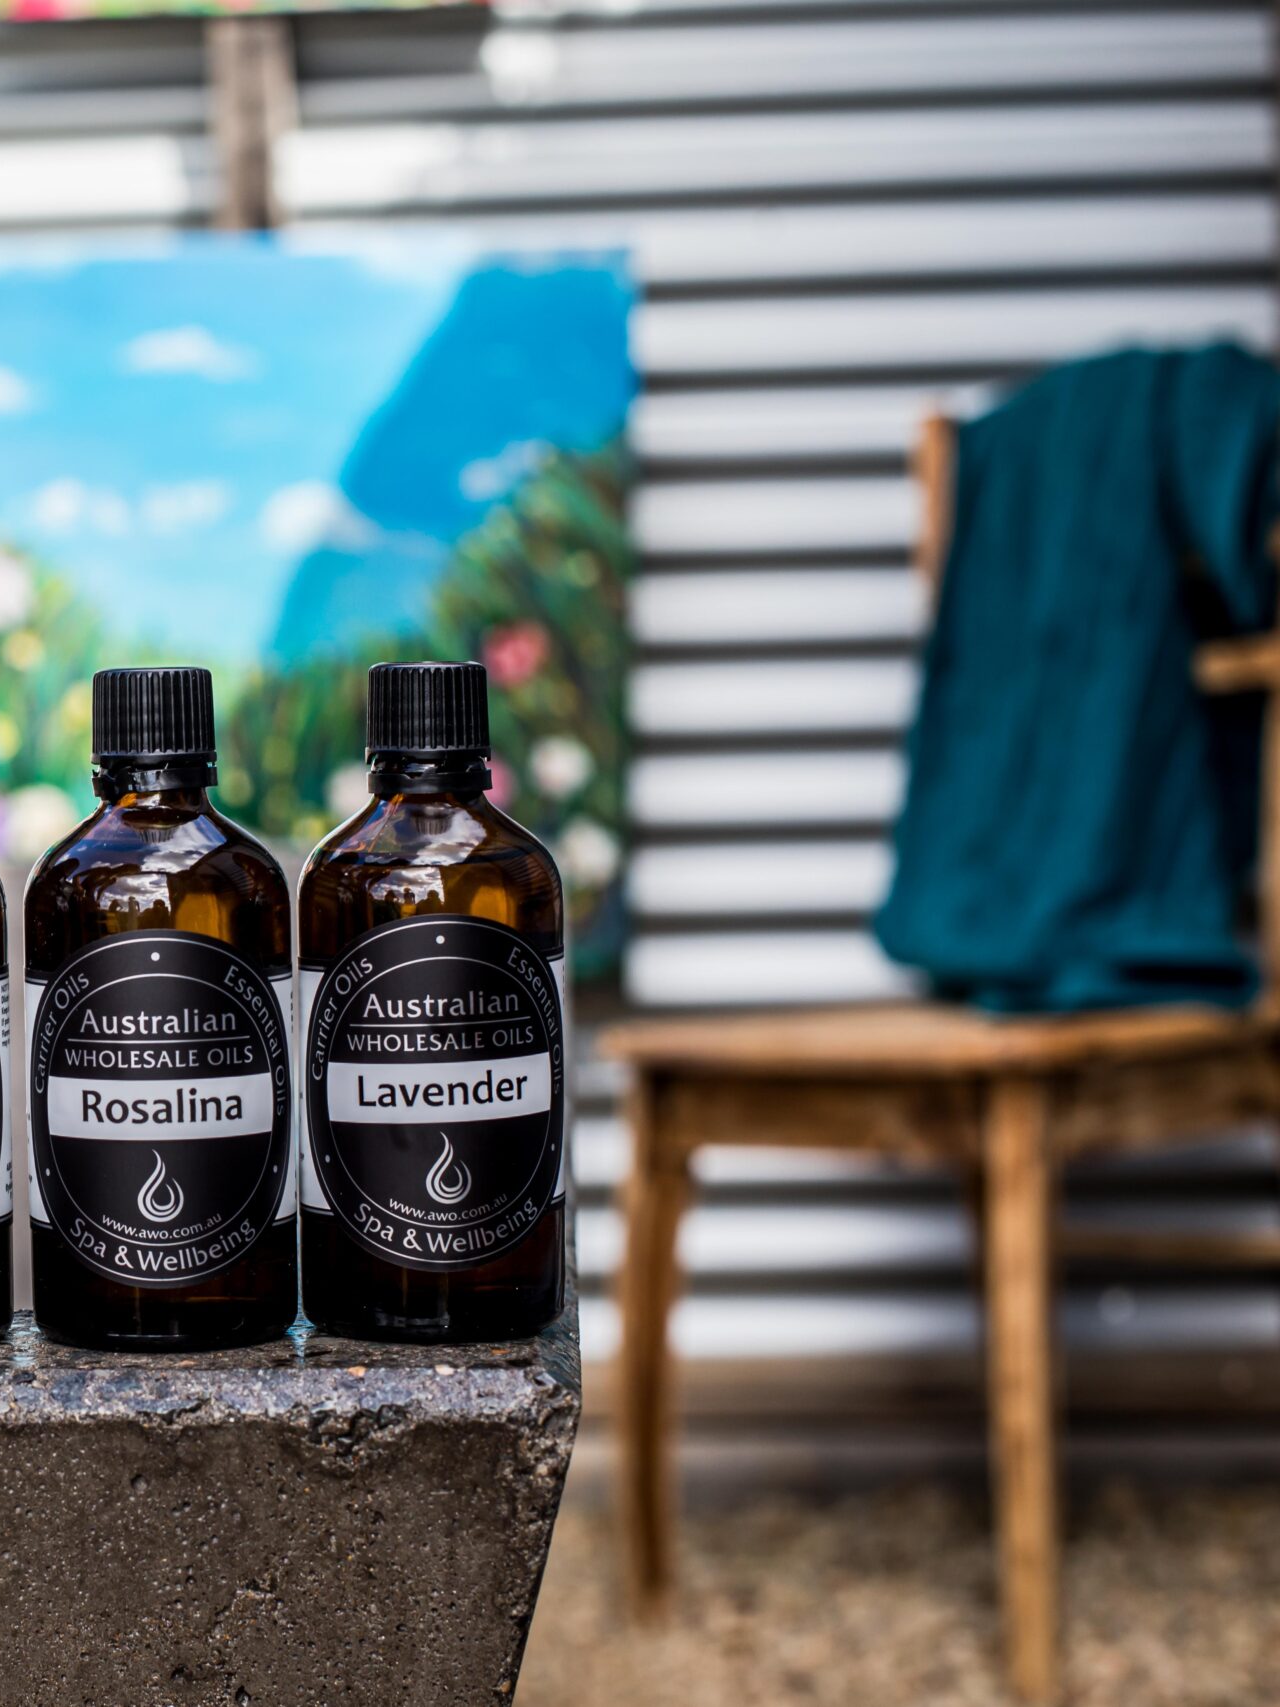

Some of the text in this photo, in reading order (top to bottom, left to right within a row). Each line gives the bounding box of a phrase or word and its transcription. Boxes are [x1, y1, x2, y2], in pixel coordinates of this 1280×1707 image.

[223, 964, 282, 1058] Essential
[362, 990, 520, 1019] Australian
[506, 946, 560, 1040] Essential
[35, 972, 90, 1095] Carrier Oils
[80, 1008, 236, 1035] Australian
[312, 956, 374, 1082] Carrier Oils
[64, 1045, 254, 1069] WHOLESALE OILS
[347, 1025, 535, 1053] WHOLESALE OILS
[82, 1088, 243, 1125] Rosalina
[358, 1069, 528, 1108] Lavender
[353, 1196, 539, 1254] Spa & Wellbeing
[388, 1192, 508, 1222] www.awo.com.au
[70, 1217, 257, 1272] Spa & Wellbeing
[101, 1212, 223, 1241] www.awo.com.au
